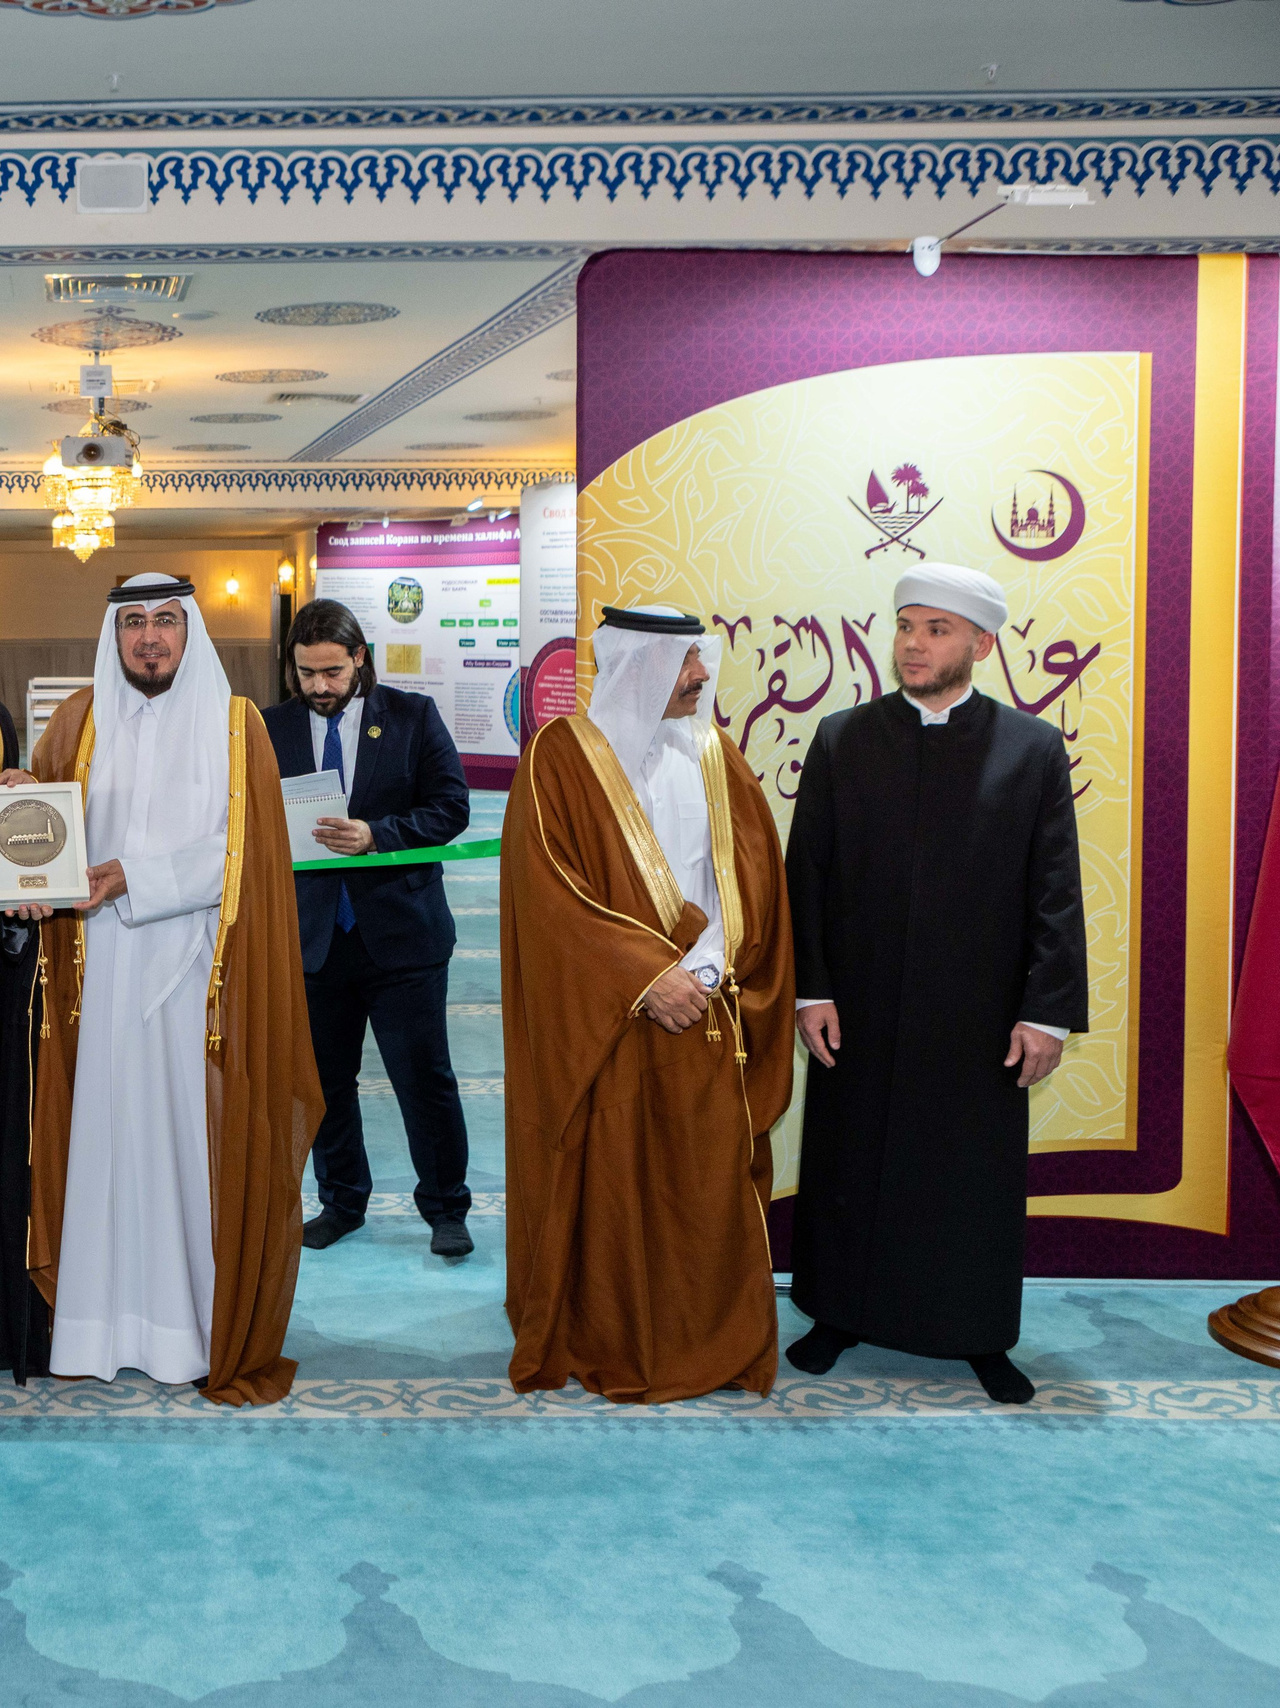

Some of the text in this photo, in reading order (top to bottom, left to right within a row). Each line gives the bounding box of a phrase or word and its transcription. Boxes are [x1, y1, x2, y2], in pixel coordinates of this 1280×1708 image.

[328, 535, 349, 547] Свод
[349, 534, 385, 546] записей
[386, 534, 419, 547] Корана
[433, 532, 474, 545] времена
[474, 528, 512, 543] халифа
